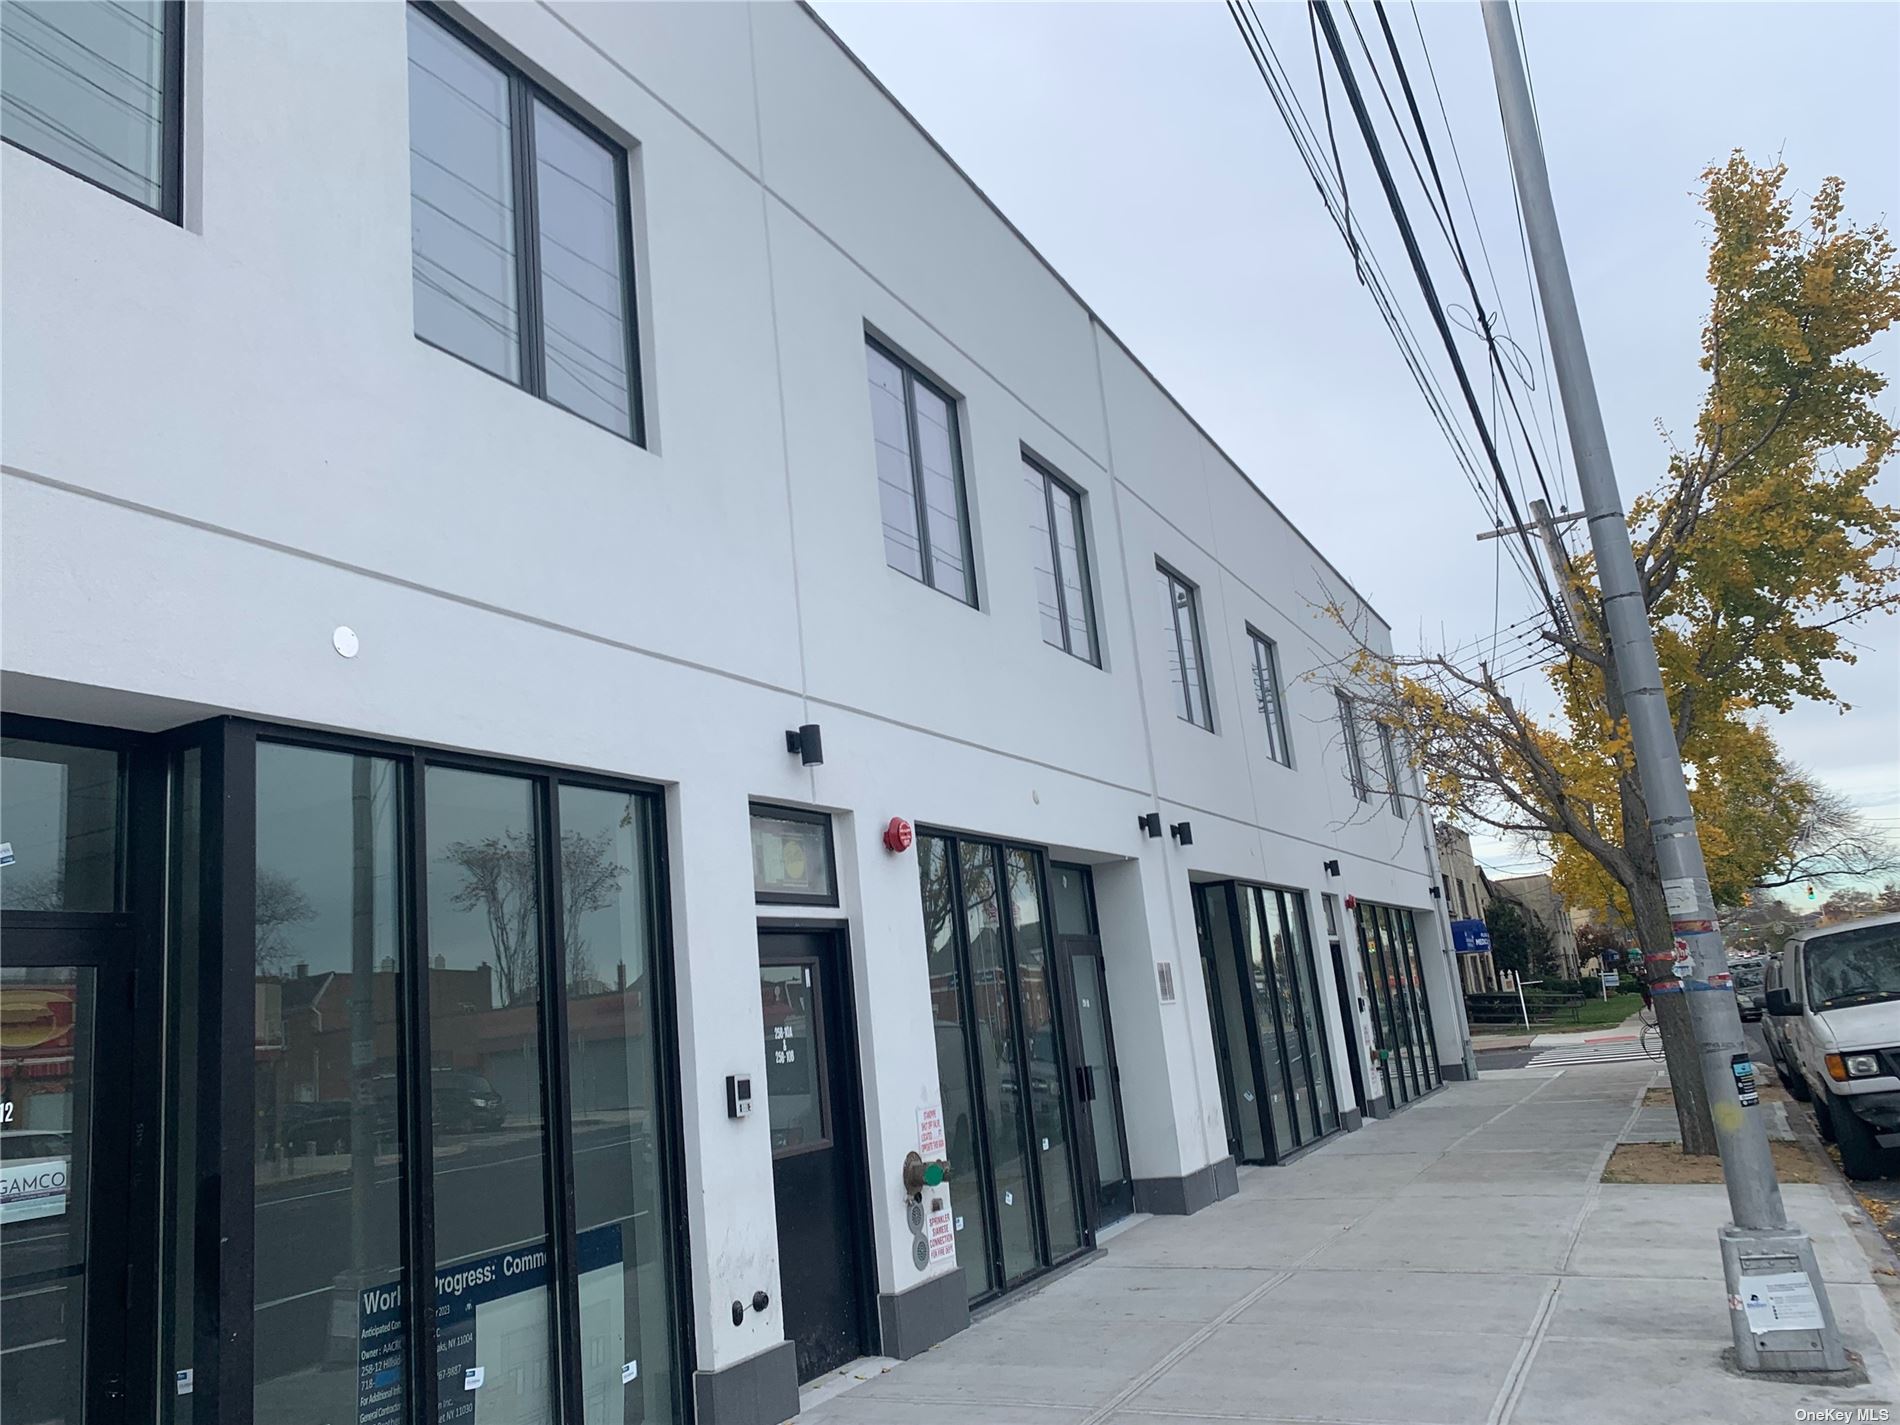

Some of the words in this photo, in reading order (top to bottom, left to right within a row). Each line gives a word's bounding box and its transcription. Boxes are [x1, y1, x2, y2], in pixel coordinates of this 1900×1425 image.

[0, 1171, 65, 1195] GAMCO
[929, 1213, 950, 1227] SPRINKLER
[929, 1233, 953, 1249] CONNECTION
[435, 1265, 496, 1296] rogress:
[503, 1252, 547, 1277] Comm
[361, 1321, 390, 1339] Anticipated
[361, 1361, 382, 1377] 258-12
[457, 1332, 473, 1347] 11004
